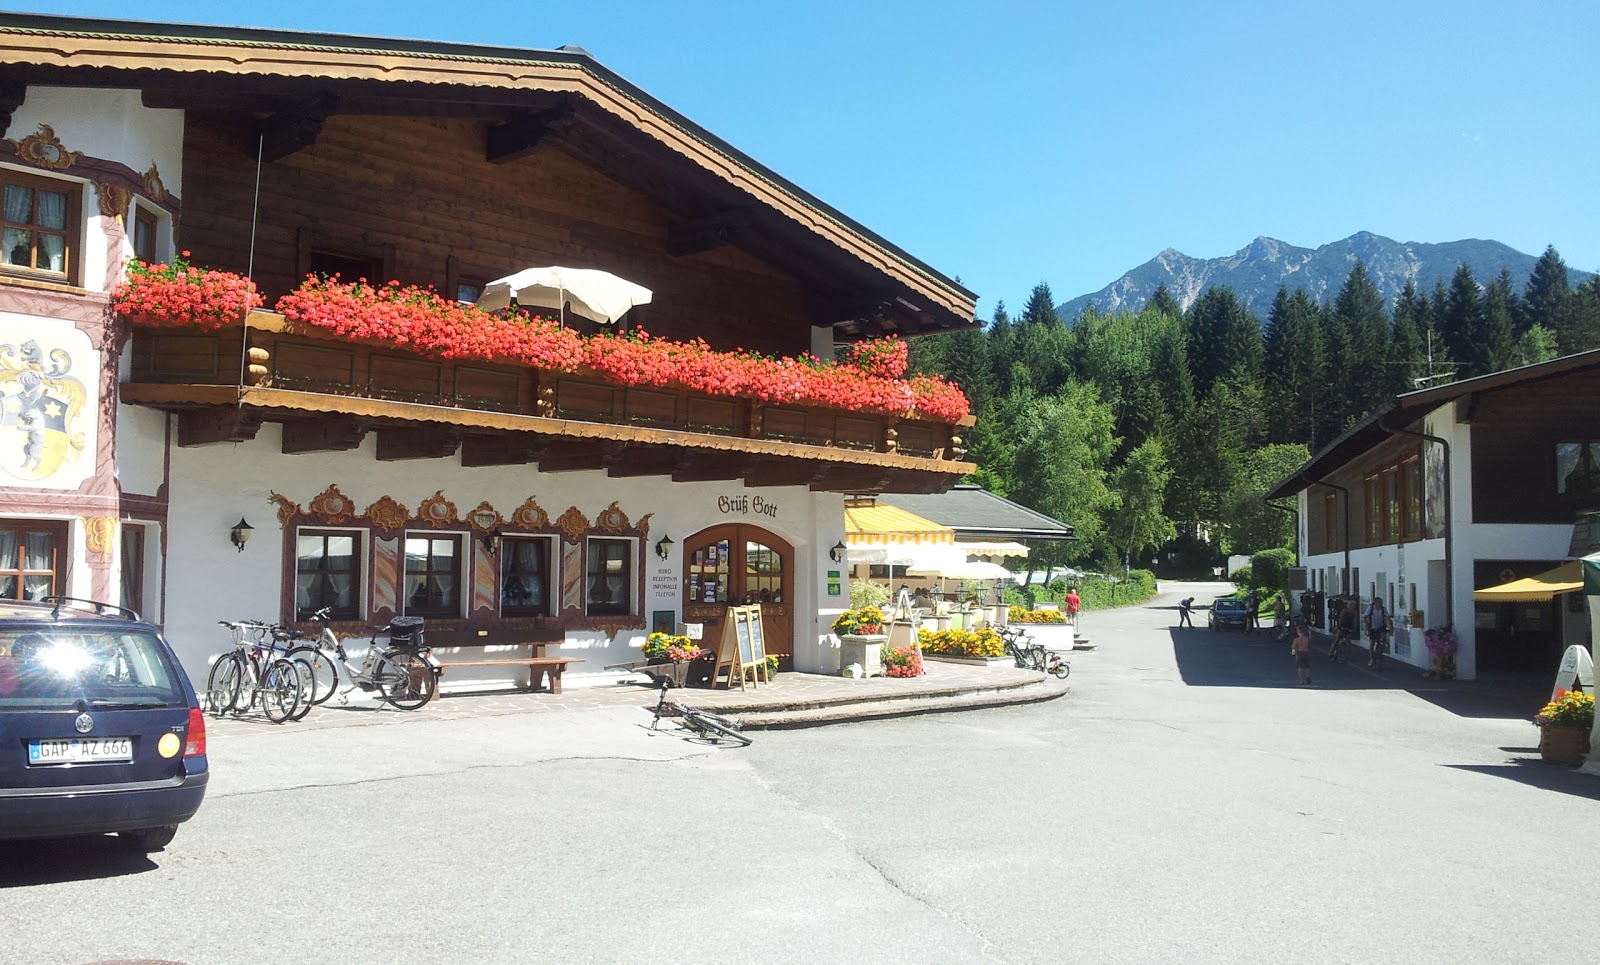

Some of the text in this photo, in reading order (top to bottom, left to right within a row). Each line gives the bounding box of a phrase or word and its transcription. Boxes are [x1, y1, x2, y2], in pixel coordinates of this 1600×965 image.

[718, 495, 777, 517] Grüß Gott
[41, 741, 69, 757] GAP
[81, 740, 99, 756] AZ
[103, 740, 128, 755] 666
